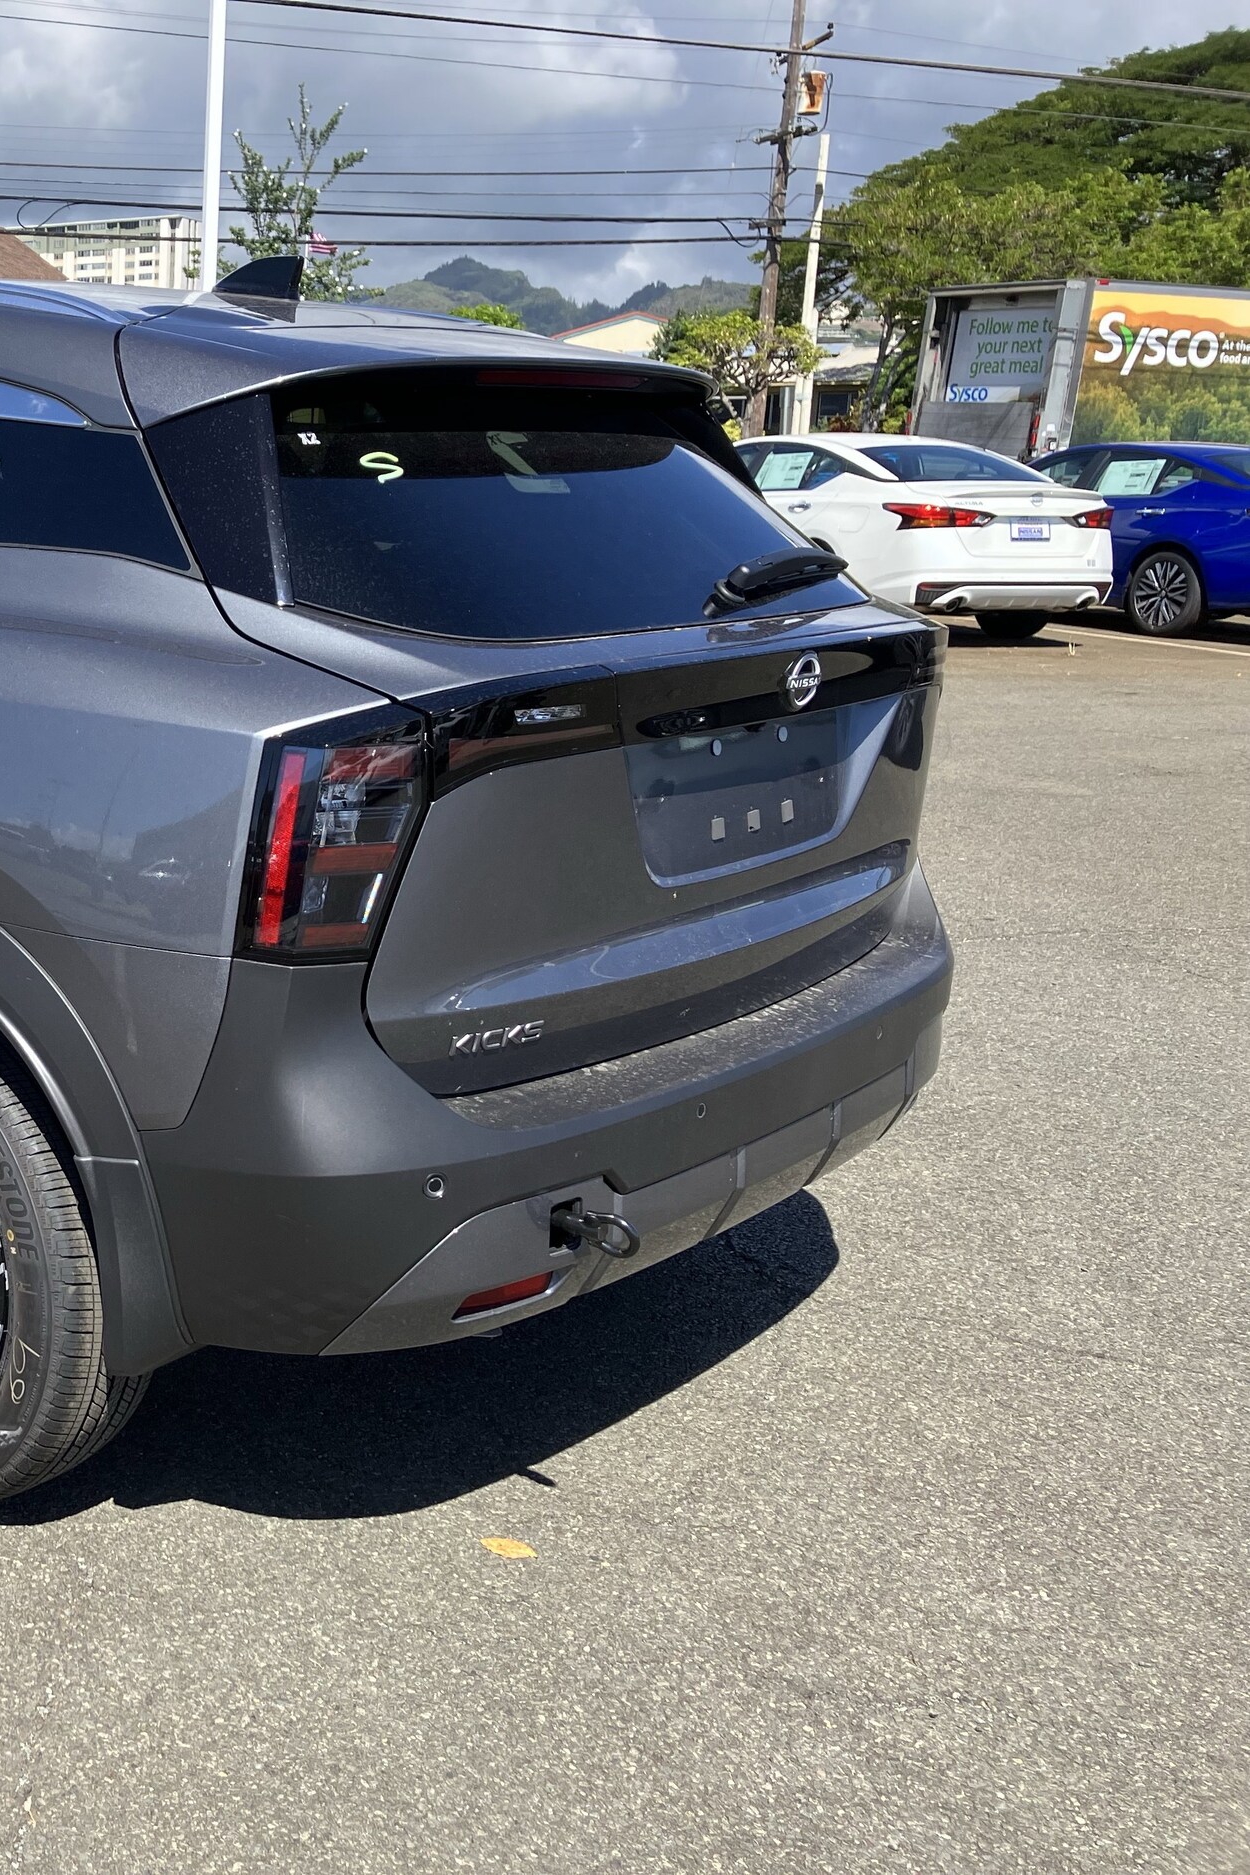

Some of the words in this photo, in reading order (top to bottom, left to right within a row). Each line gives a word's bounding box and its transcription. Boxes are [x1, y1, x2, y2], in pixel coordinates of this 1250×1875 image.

[969, 317, 1013, 336] Follow
[1016, 320, 1039, 333] me
[976, 340, 1008, 359] your
[1011, 337, 1042, 353] next
[1093, 311, 1219, 376] Sysco
[1222, 339, 1235, 350] At
[969, 358, 1006, 378] great
[1009, 355, 1044, 373] meal
[1220, 351, 1241, 364] food
[949, 384, 988, 402] Sysco
[449, 1020, 545, 1057] KICKS
